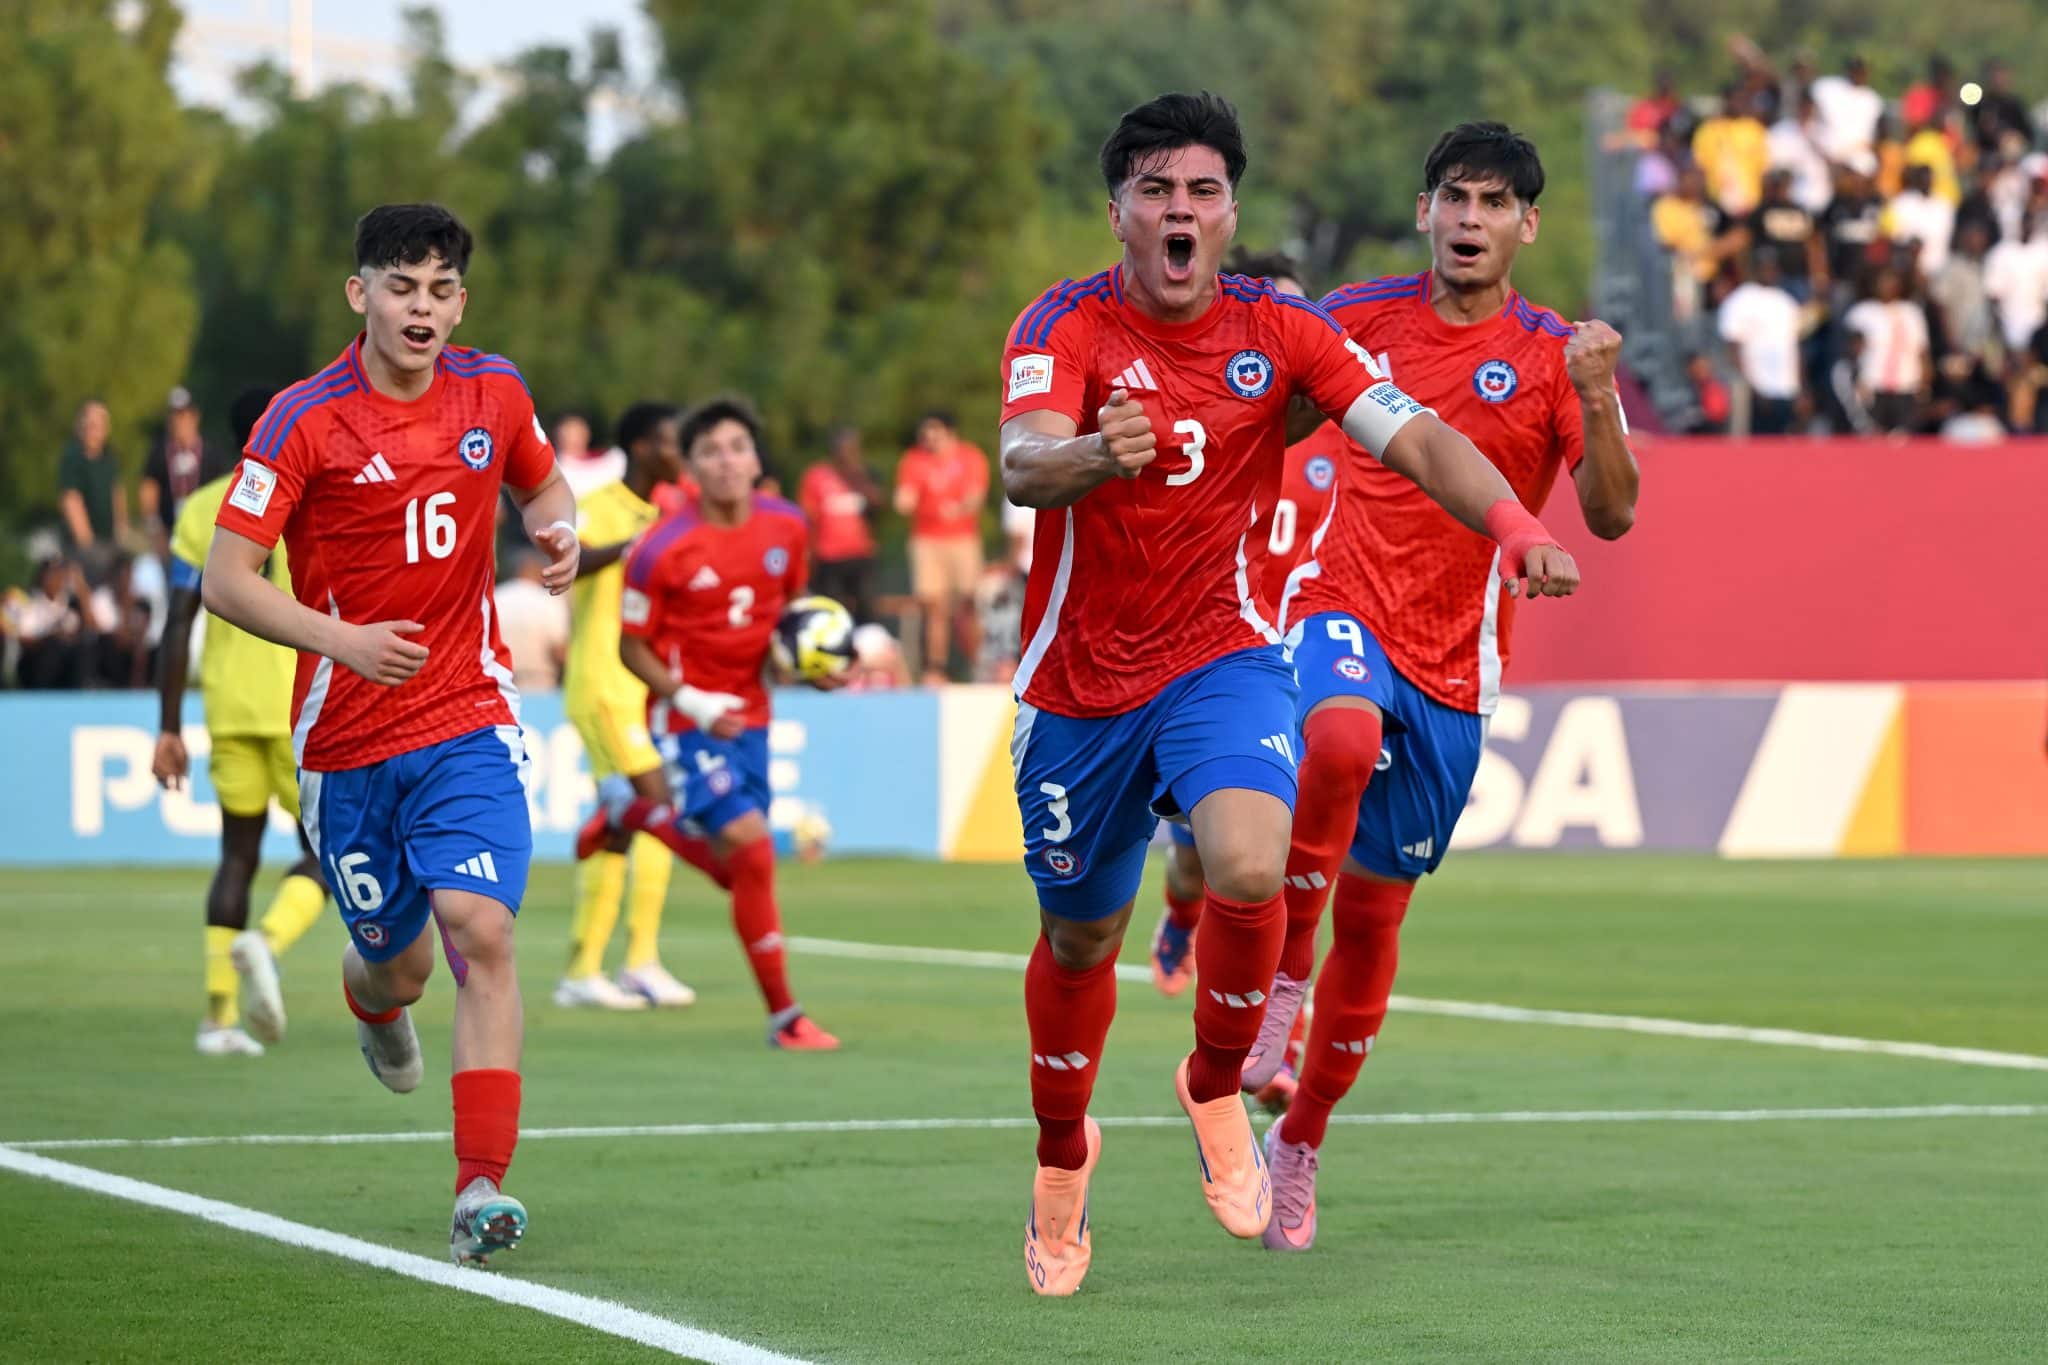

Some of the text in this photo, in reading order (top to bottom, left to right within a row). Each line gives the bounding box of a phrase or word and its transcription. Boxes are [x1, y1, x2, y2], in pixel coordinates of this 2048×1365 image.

[1165, 419, 1206, 486] 3
[404, 491, 457, 564] 16
[1267, 498, 1297, 556] 0
[728, 585, 755, 628] 2
[1326, 619, 1365, 658] 9
[1446, 694, 1644, 849] SA
[1040, 782, 1072, 842] 3
[329, 852, 384, 911] 16
